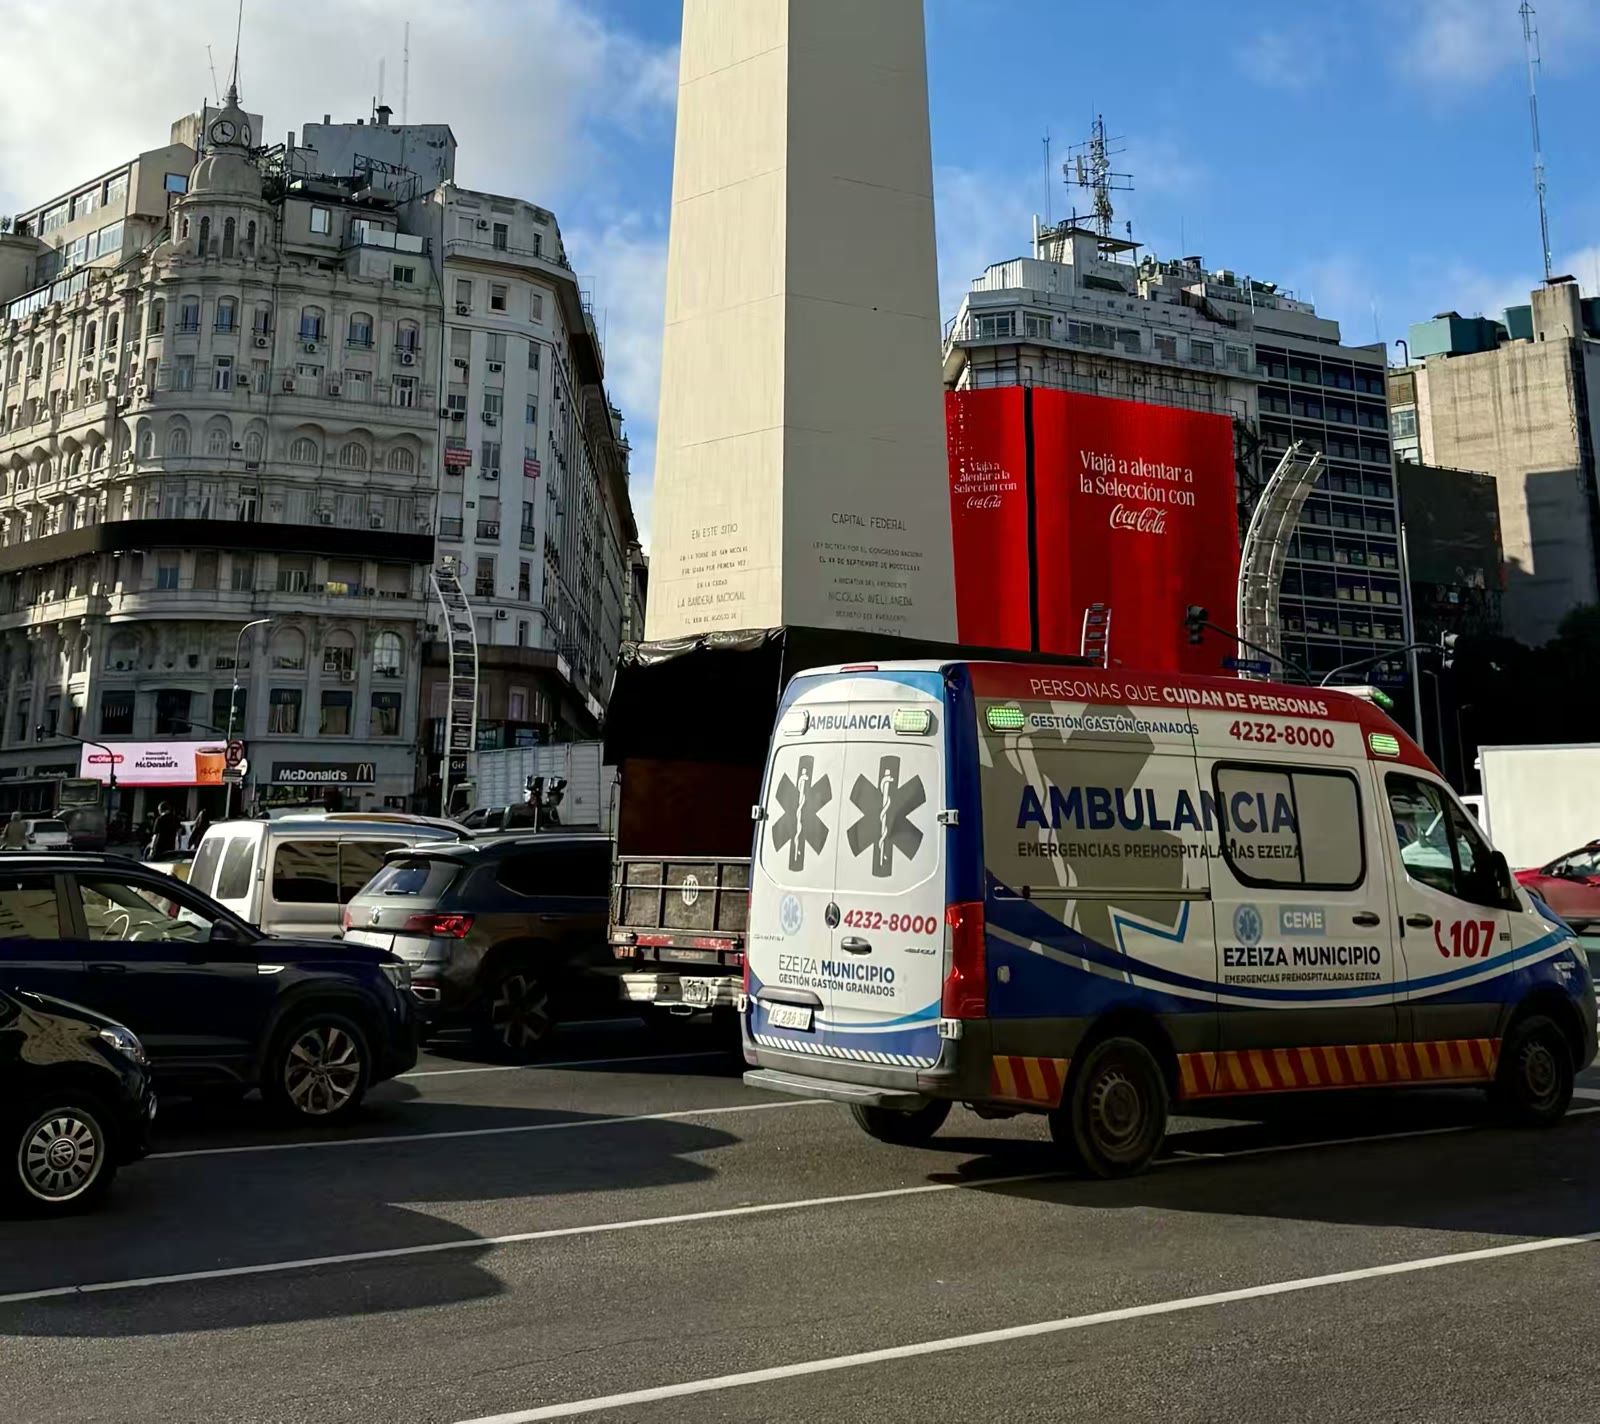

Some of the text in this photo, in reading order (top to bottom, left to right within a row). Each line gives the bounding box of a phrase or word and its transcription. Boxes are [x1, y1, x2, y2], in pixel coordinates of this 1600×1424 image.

[1080, 450, 1193, 483] Viajá a alentar a
[1080, 473, 1195, 506] la Selección con
[691, 523, 738, 540] EN ESTE SITIO
[831, 512, 907, 531] CAPITAL FEDERAL
[677, 598, 685, 608] LA
[687, 594, 714, 607] BANDERA
[1030, 679, 1328, 716] PERSONAS QUE CUIDAN DE PERSONAS
[809, 715, 891, 730] AMBULANCIA
[1031, 714, 1199, 735] GESTIÓN GASTÓN GRANADOS
[1229, 720, 1335, 748] 4232-8000
[279, 769, 348, 781] McDonald's
[1016, 784, 1298, 833] AMBULANCIA
[1018, 842, 1120, 858] EMERGENCIAS
[1258, 844, 1300, 859] EZEIZA
[844, 910, 937, 935] 4232-8000
[1283, 912, 1322, 929] CEME
[1450, 919, 1495, 958] 107
[1223, 946, 1380, 967] EZEIZA MUNICIPIO
[779, 954, 895, 984] EZEIZA MUNICIPIO
[1224, 972, 1381, 984] EMERGENCIAS PREHOSPITALARIAS EZEIZA
[778, 973, 895, 997] GESTIÓN GASTÓN GRANADOS
